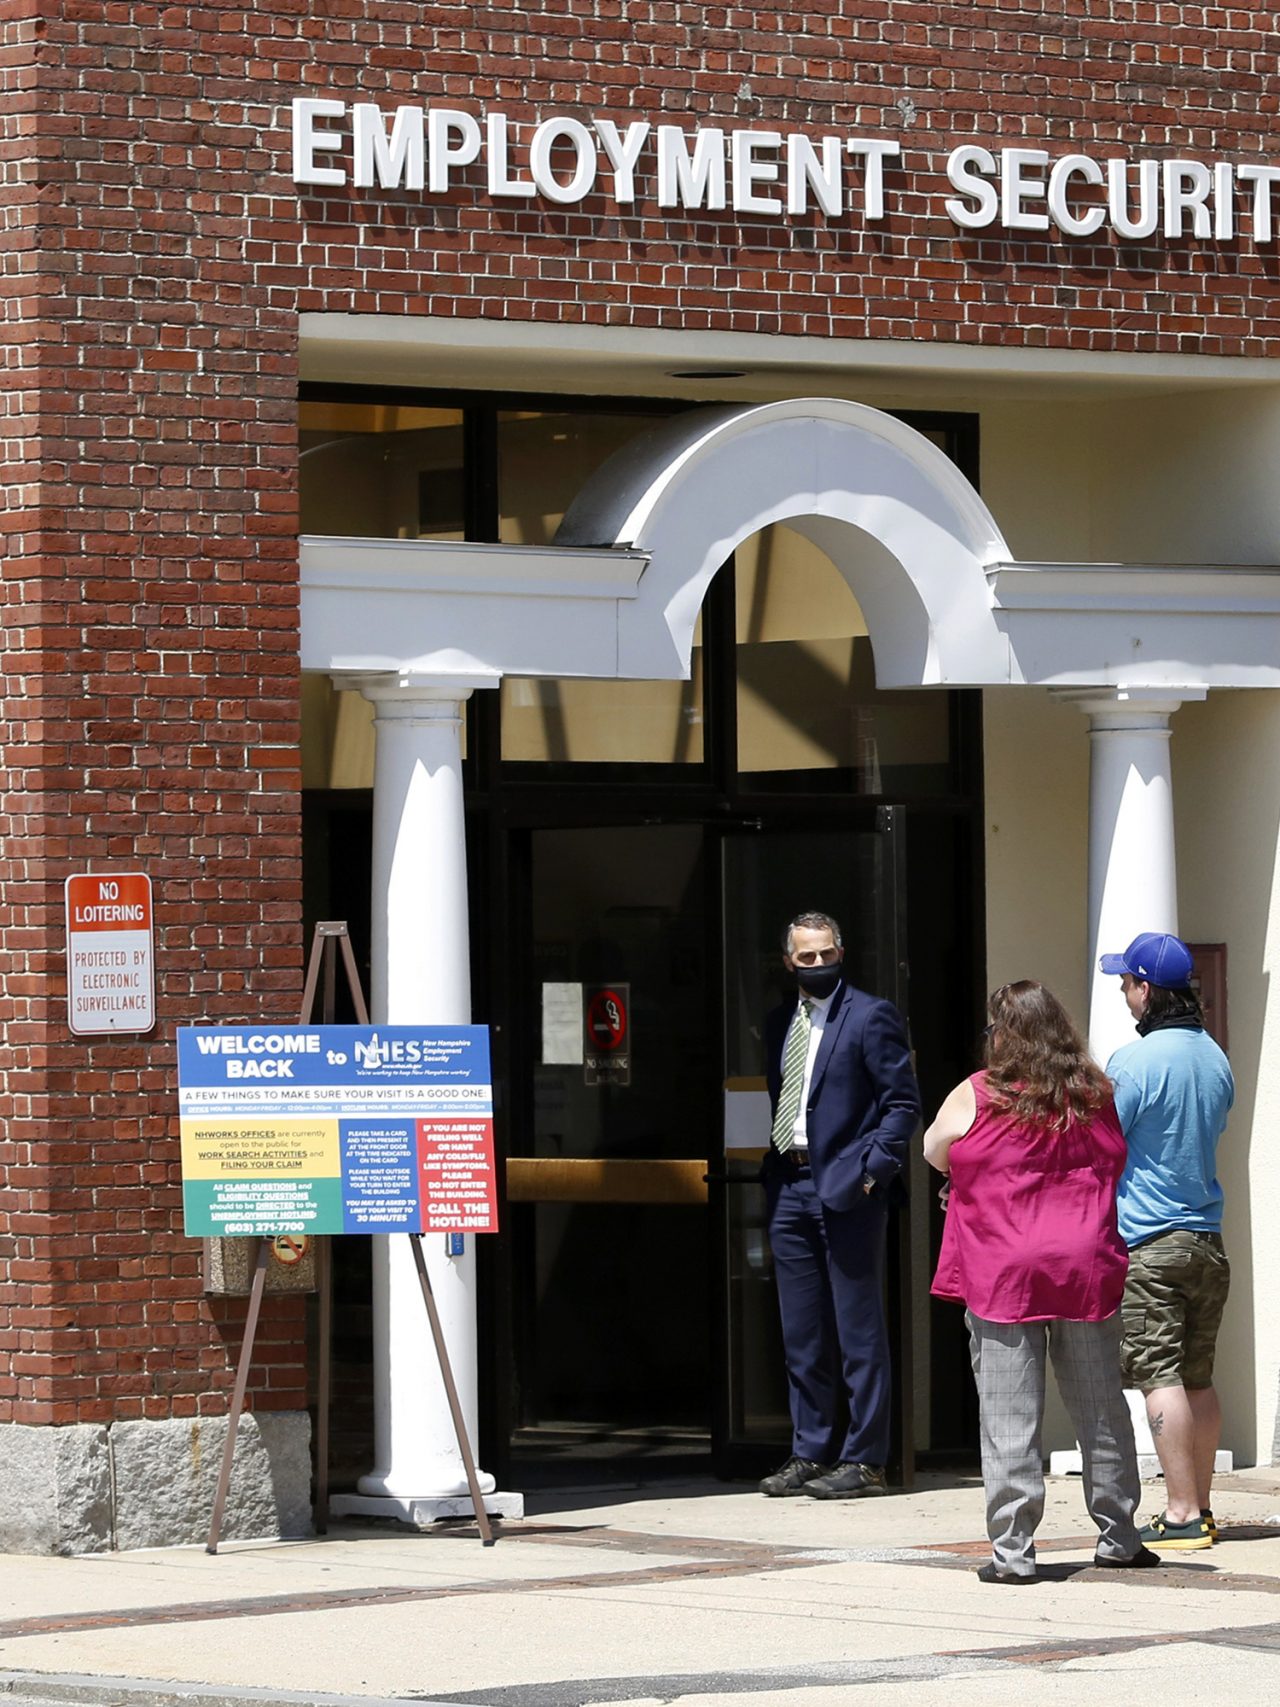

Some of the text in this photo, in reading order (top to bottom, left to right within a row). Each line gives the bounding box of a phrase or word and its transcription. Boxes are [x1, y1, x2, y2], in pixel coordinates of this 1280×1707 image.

[292, 97, 900, 221] EMPLOYMENT
[99, 881, 119, 900] NO
[75, 904, 144, 923] LOITERING
[75, 950, 146, 967] PROTECTED BY
[82, 973, 139, 989] ELECTRONIC
[76, 995, 147, 1012] SURVEILLANCE
[196, 1035, 321, 1055] WELCOME
[354, 1040, 421, 1062] NHES
[423, 1047, 462, 1055] Employment
[326, 1050, 348, 1065] to
[423, 1055, 450, 1063] Security
[226, 1059, 295, 1079] BACK
[185, 1089, 487, 1100] A FEW THINGS TO MAKE SURE YOUR VISIT IS A GOOD ONE:
[194, 1131, 238, 1139] NHWORKS
[240, 1130, 276, 1138] OFFICES
[266, 1140, 288, 1148] public
[226, 1151, 261, 1159] SEARCH
[262, 1150, 308, 1158] ACTIVITIES
[220, 1161, 248, 1169] FILING
[276, 1160, 302, 1168] CLAIM
[224, 1184, 250, 1192] CLAIM
[250, 1183, 297, 1192] QUESTIONS
[262, 1192, 309, 1201] QUESTIONS
[256, 1202, 295, 1211] DIRECTED
[427, 1202, 490, 1214] CALL THE
[369, 1214, 408, 1222] MINUTES
[429, 1216, 490, 1228] HOTLINE!
[224, 1222, 305, 1234] (603) 271-7700
